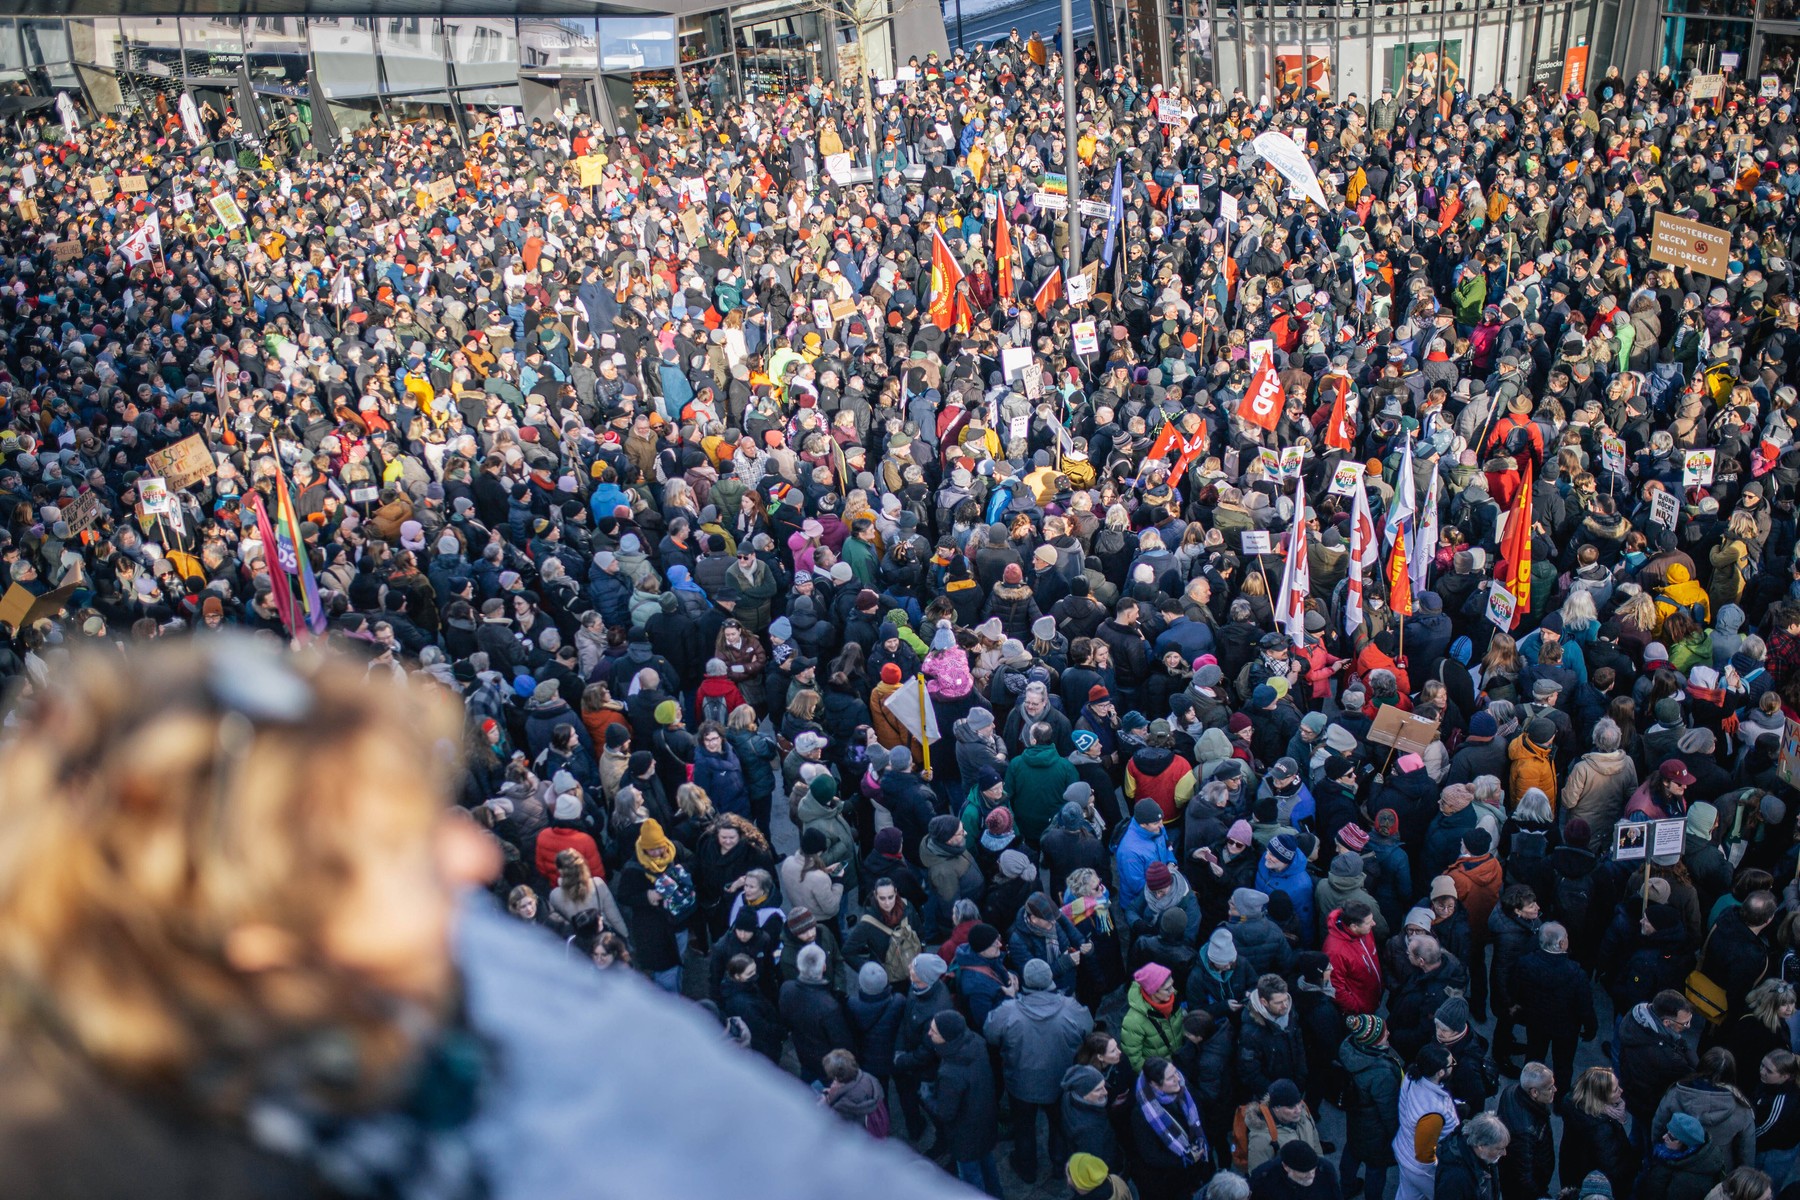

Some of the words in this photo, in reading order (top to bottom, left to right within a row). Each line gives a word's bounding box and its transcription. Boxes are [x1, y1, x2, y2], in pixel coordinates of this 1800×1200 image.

[1658, 233, 1687, 246] GEGEN
[1252, 369, 1280, 415] SPD
[1286, 461, 1296, 469] AFD
[1341, 477, 1353, 485] AFD
[150, 494, 162, 503] AFD
[1658, 493, 1675, 506] BJÖRN
[1655, 508, 1674, 524] NAZI
[1495, 605, 1508, 617] AFD
